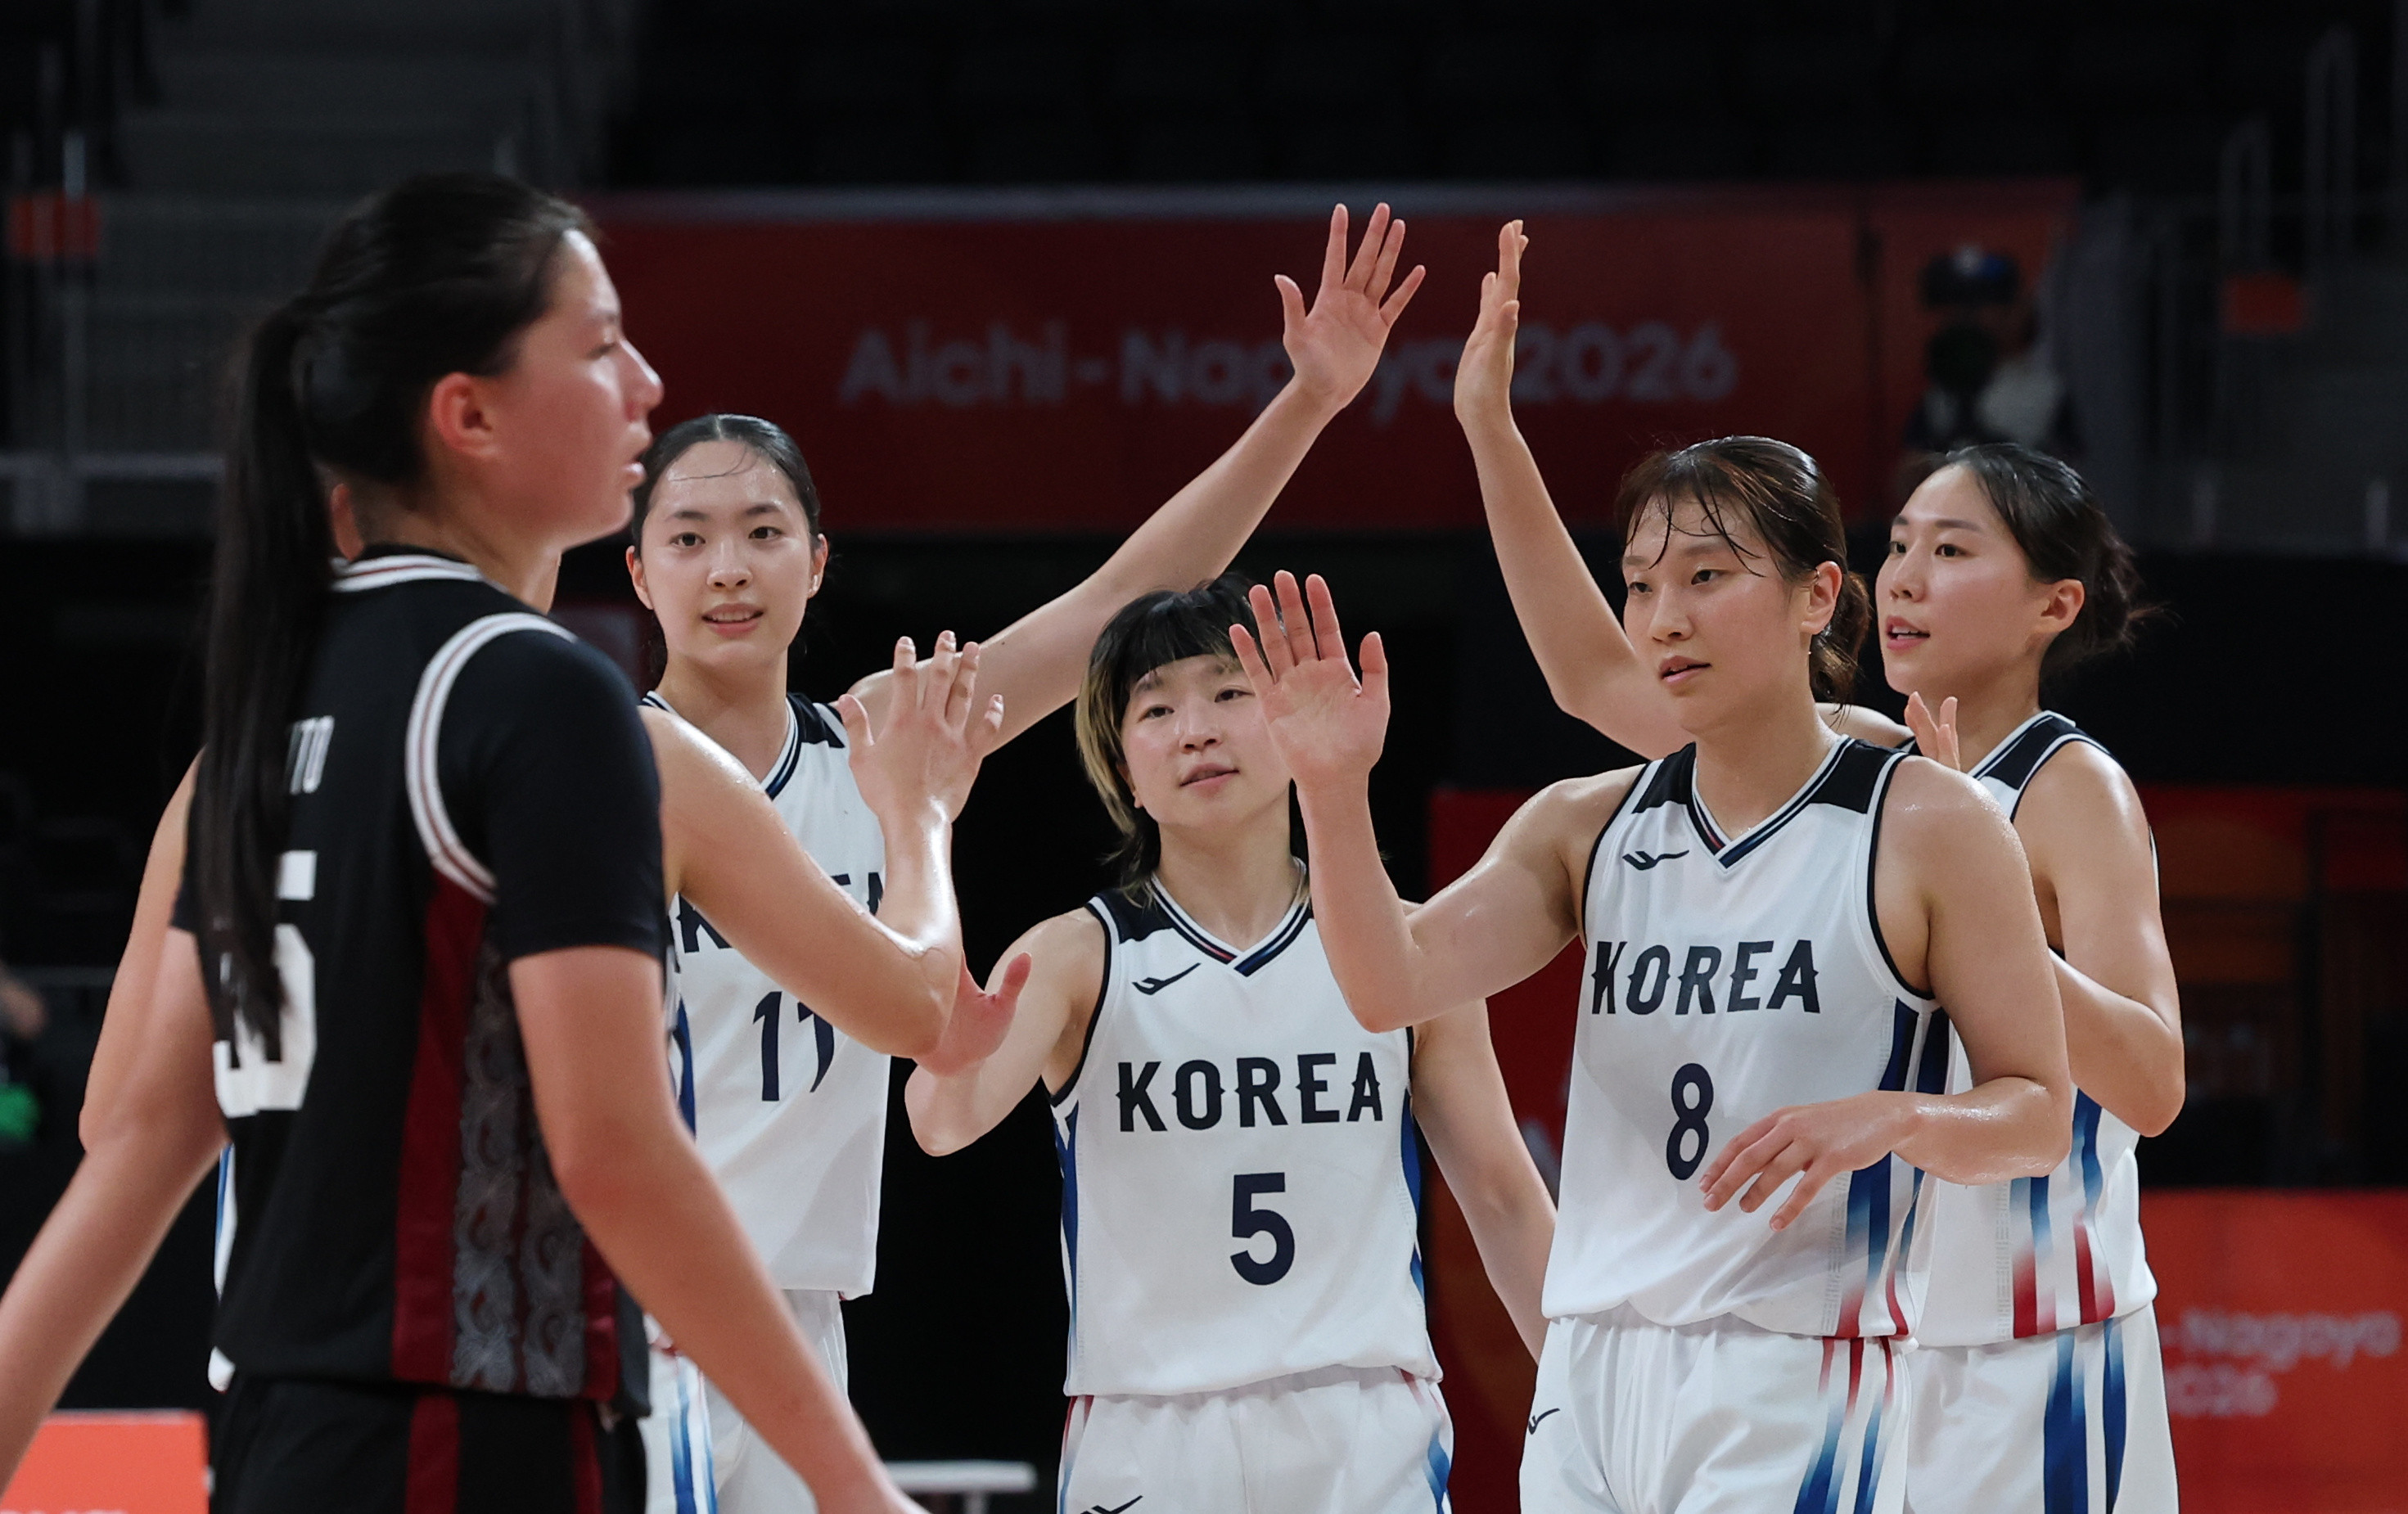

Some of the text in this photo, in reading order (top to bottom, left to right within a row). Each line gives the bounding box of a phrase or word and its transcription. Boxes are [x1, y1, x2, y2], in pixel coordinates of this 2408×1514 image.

[836, 321, 1737, 424] Aichi-Nagya 2026
[1591, 939, 1820, 1015] KOREA
[1116, 1052, 1383, 1132] KOREA
[1666, 1062, 1714, 1180] 8
[1229, 1172, 1295, 1285] 5
[2163, 1363, 2279, 1417] 026
